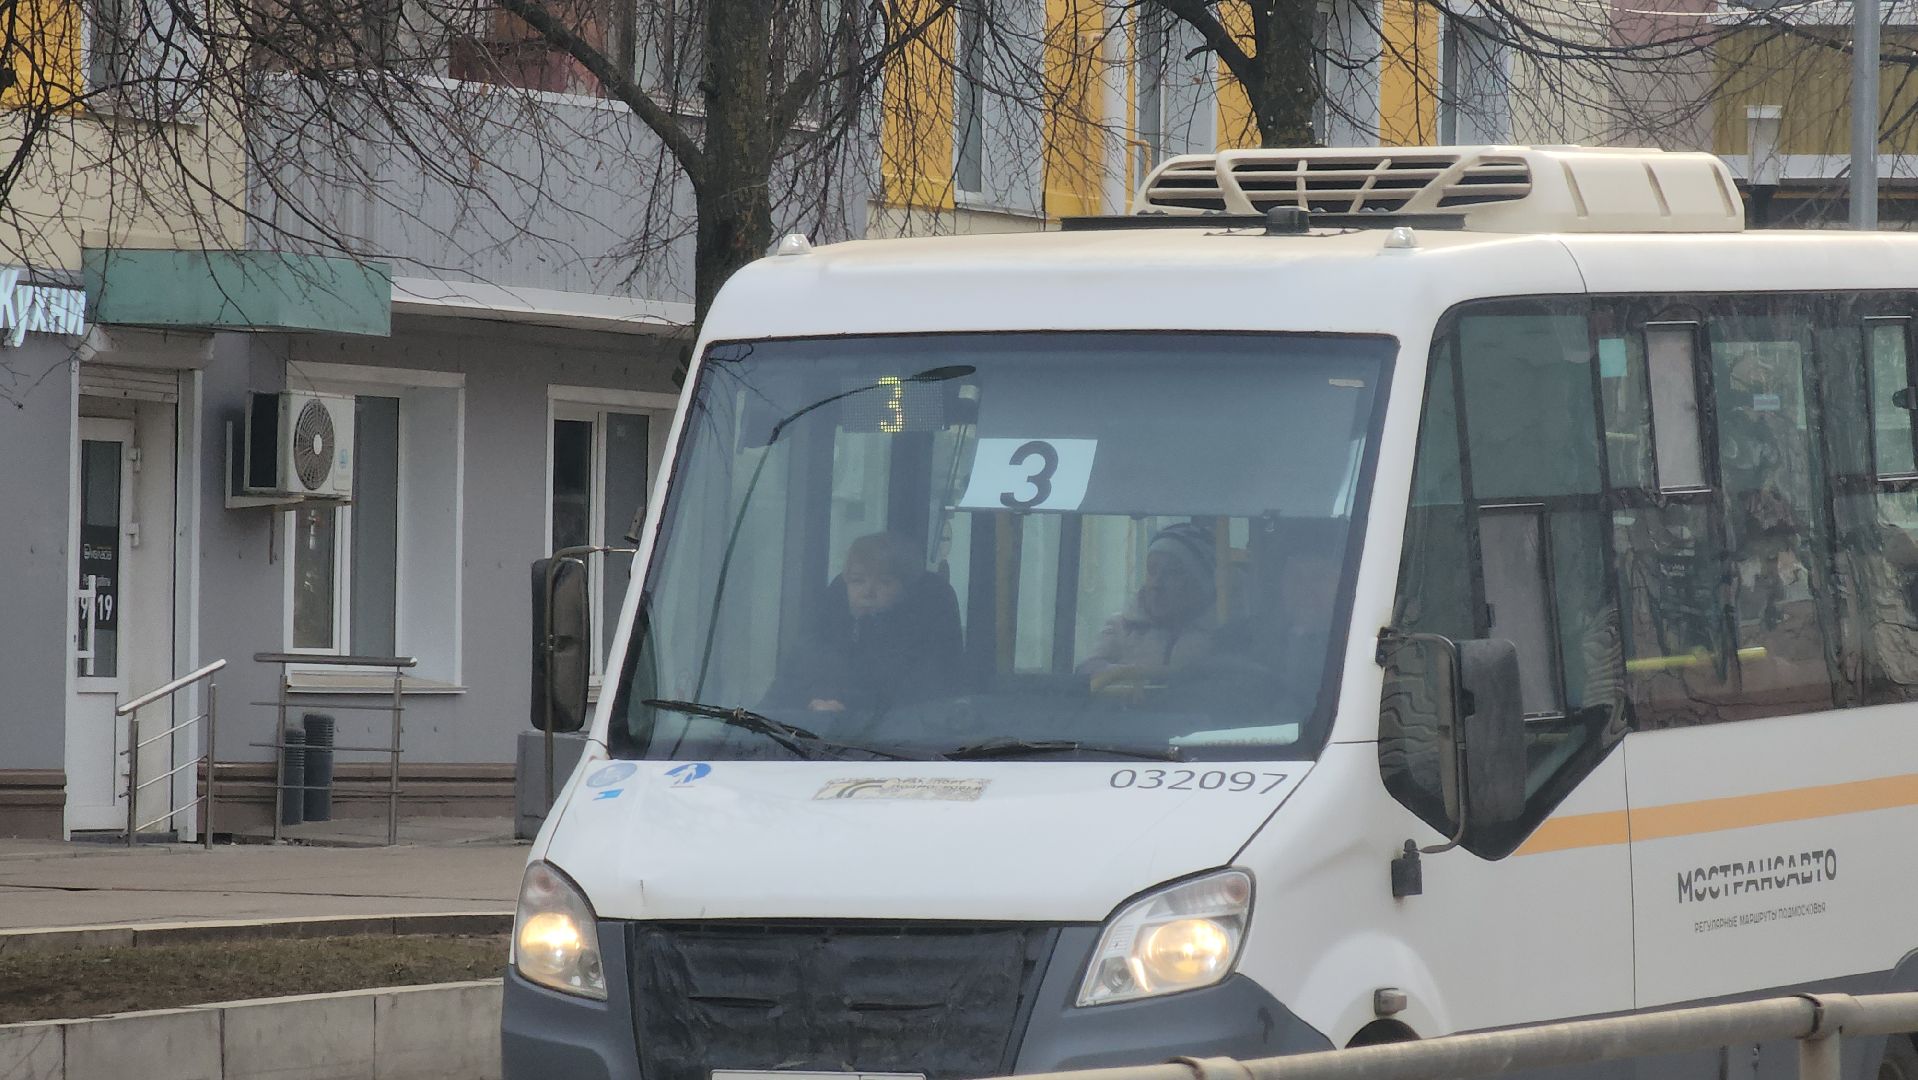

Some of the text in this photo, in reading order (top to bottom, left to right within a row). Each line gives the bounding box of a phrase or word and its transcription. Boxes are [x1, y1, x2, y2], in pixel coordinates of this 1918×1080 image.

[878, 376, 903, 433] 3
[1000, 440, 1059, 509] 3
[97, 594, 113, 621] 19
[1110, 769, 1289, 795] 032097
[1677, 848, 1837, 904] МОСТРАНСАВТО
[1694, 902, 1827, 934] РЕГУЛЯРНЫЕ МАРШРУТЫ ПОДМОСКОВЬЯ
